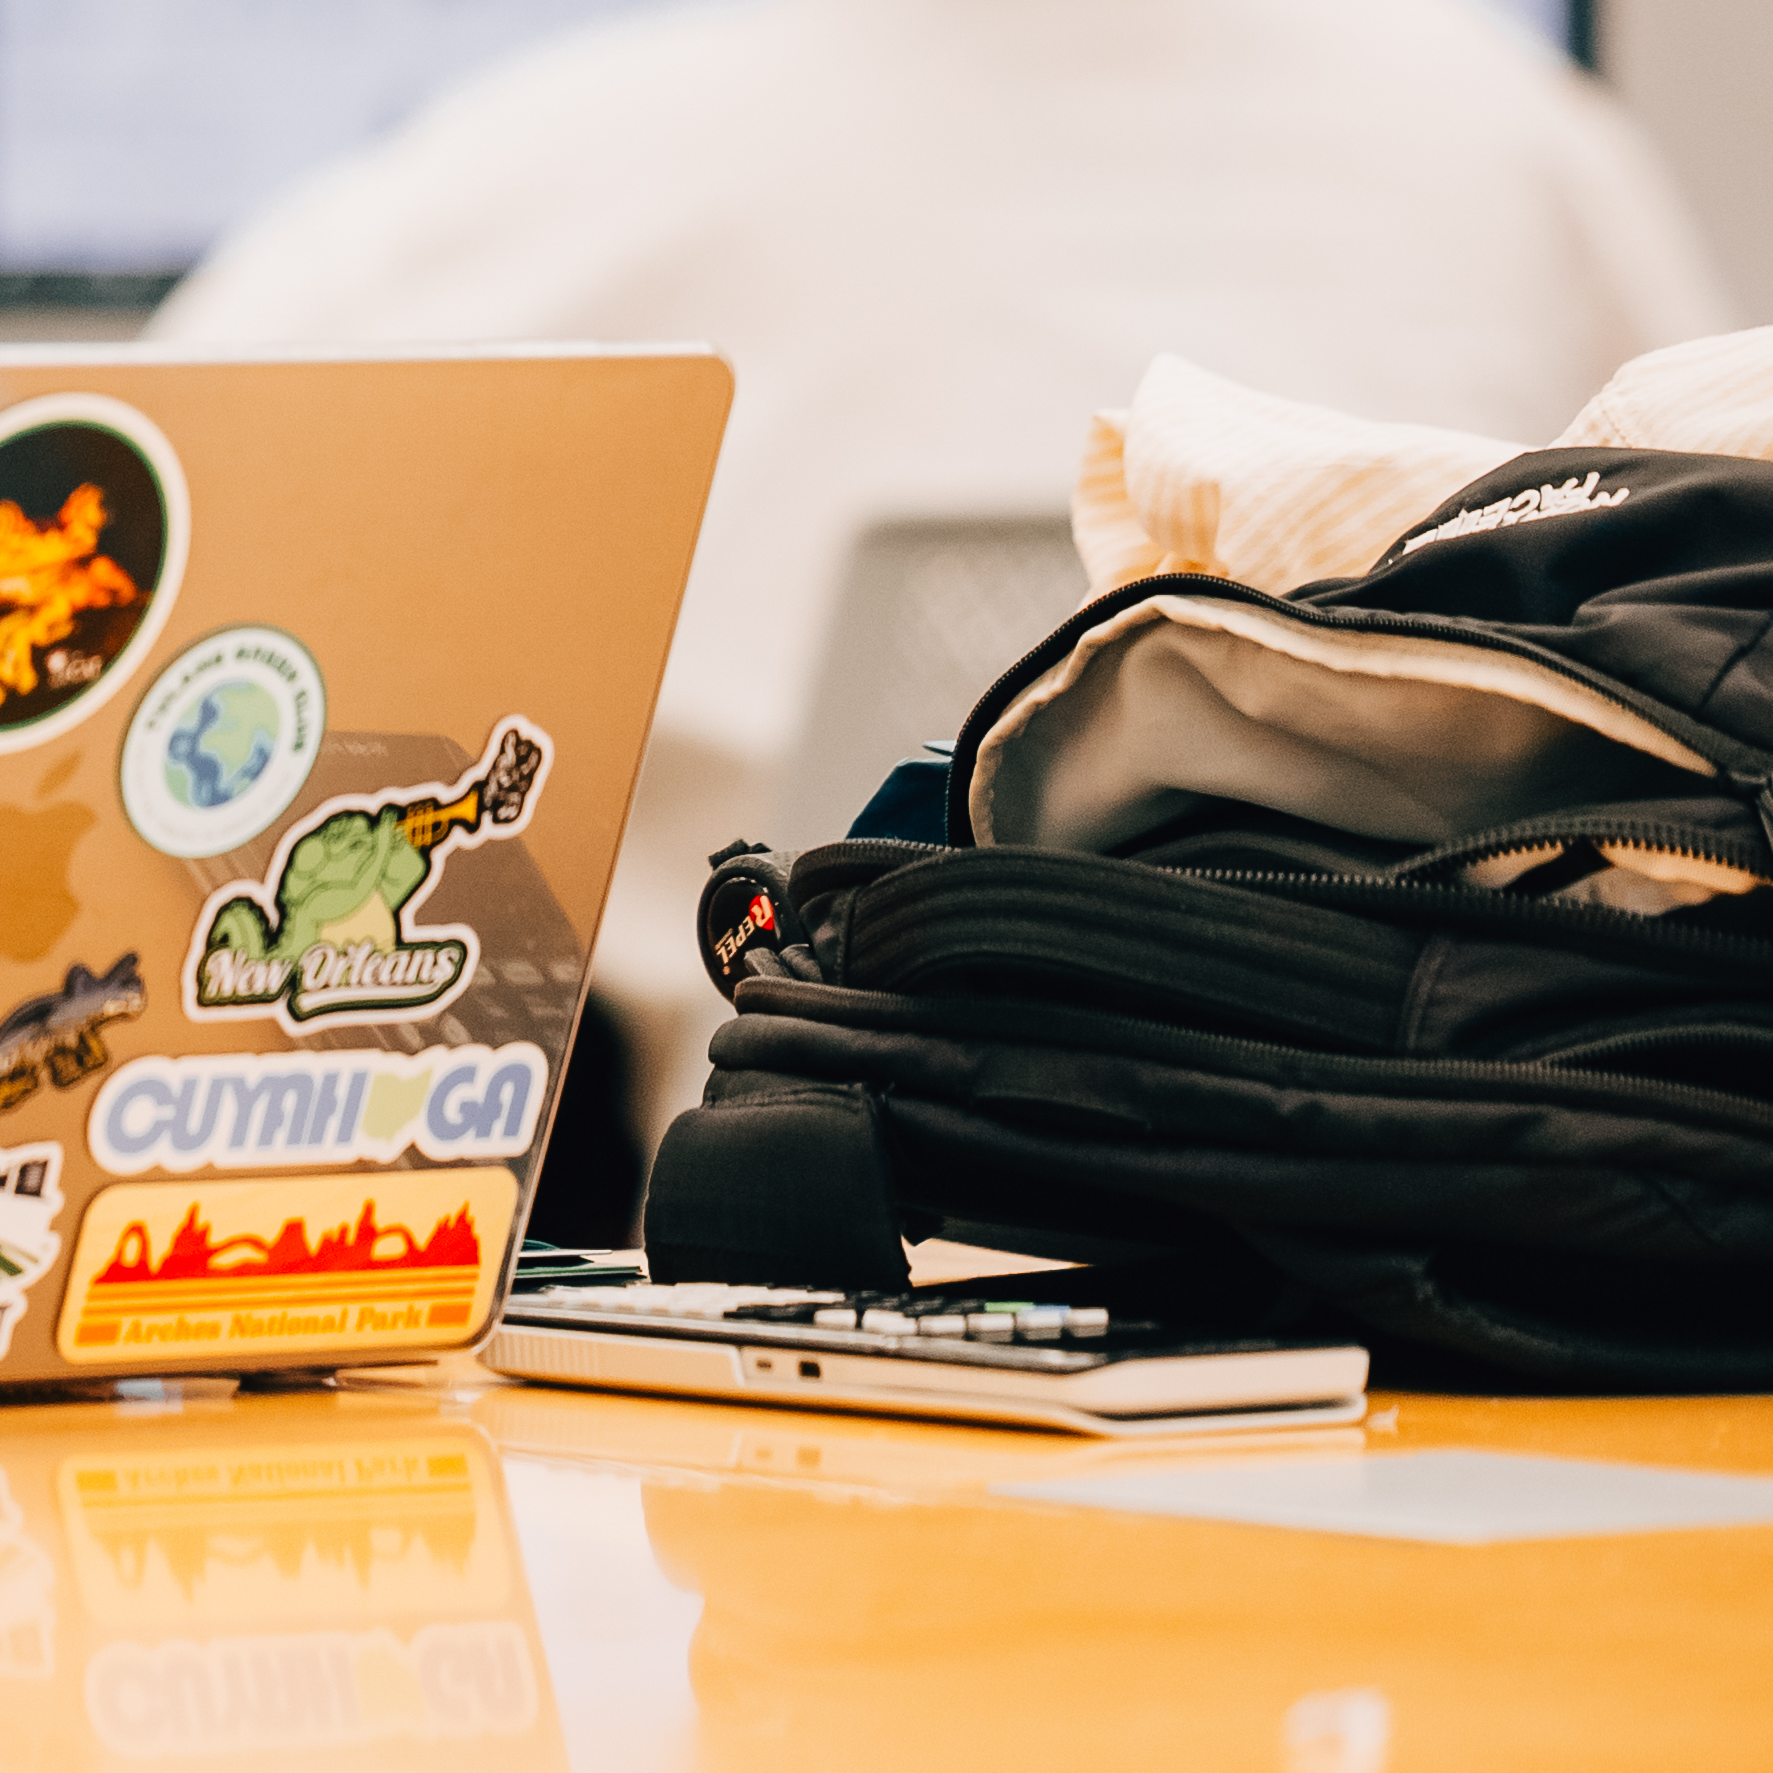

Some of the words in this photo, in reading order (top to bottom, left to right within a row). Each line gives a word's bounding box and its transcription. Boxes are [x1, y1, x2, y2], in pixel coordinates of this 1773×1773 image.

[203, 947, 293, 998] New
[300, 931, 460, 992] Orleans
[122, 1315, 221, 1344] Arches
[229, 1306, 349, 1339] National
[355, 1303, 423, 1333] Park
